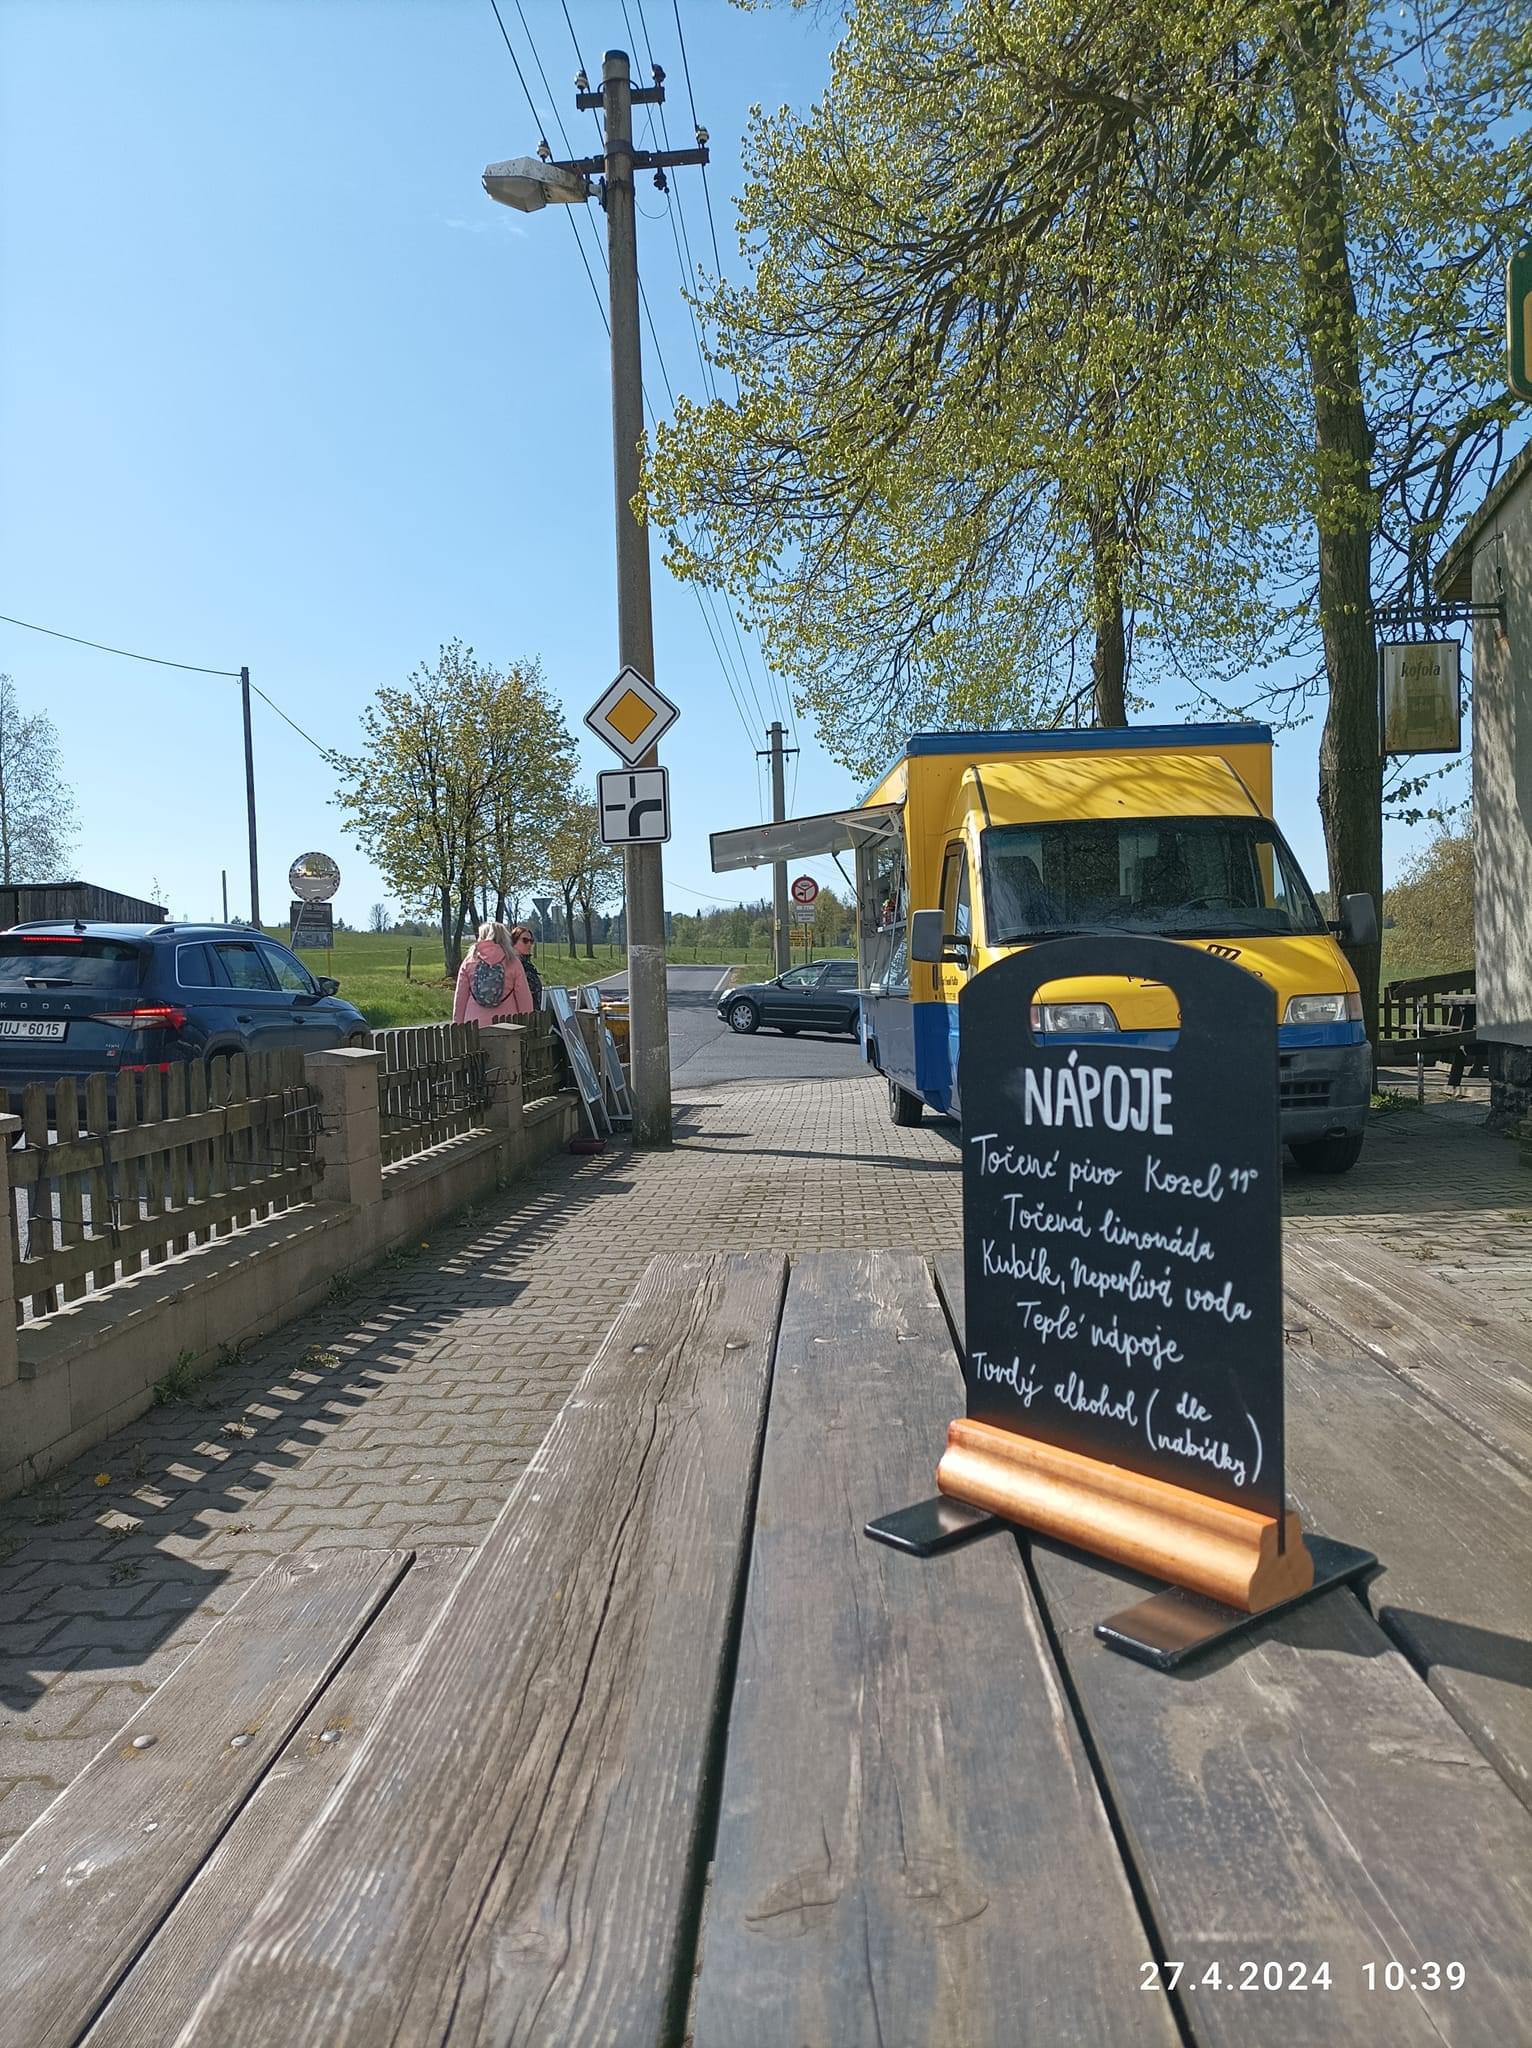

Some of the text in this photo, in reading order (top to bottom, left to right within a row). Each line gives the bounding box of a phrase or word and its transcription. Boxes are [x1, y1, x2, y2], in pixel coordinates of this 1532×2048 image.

[28, 1023, 60, 1036] 6015
[1025, 1049, 1173, 1135] NÁPOJE
[971, 1134, 1060, 1179] Točené
[1069, 1159, 1122, 1192] pivo
[1145, 1155, 1223, 1202] Kozel
[1004, 1194, 1214, 1262] Točená limonáda
[1071, 1257, 1173, 1308] Neperlivá
[1186, 1282, 1252, 1322] voda
[1017, 1301, 1184, 1371] Teplé nápoje
[972, 1352, 1044, 1407] Tvrdý
[1054, 1372, 1138, 1426] alkohol
